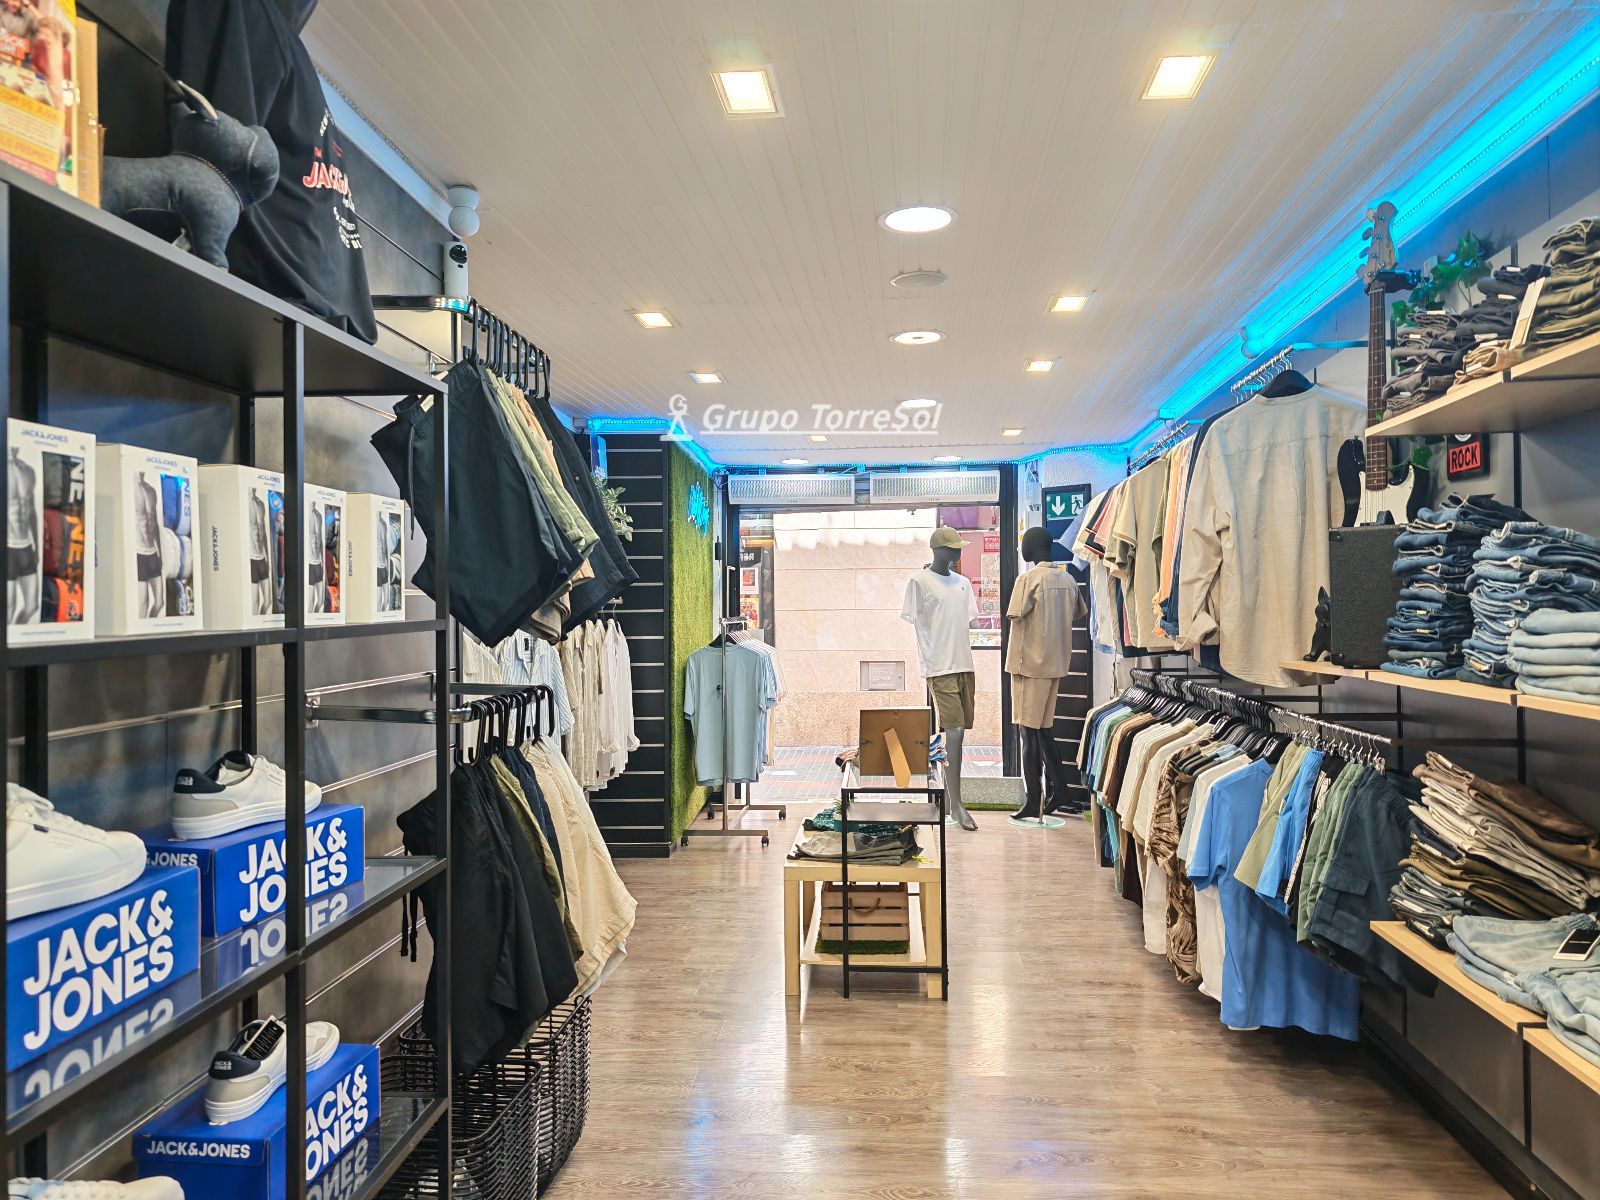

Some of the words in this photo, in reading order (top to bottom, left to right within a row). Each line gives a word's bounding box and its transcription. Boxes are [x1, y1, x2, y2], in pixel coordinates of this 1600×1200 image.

[1451, 445, 1478, 470] ROCK
[239, 817, 347, 884] JAK&
[239, 852, 348, 922] JOES
[23, 889, 174, 996] JACK&
[23, 935, 174, 1050] JONES
[306, 1064, 368, 1140] ACK&
[147, 1140, 251, 1159] JACK&JONES
[306, 1097, 368, 1181] ONES
